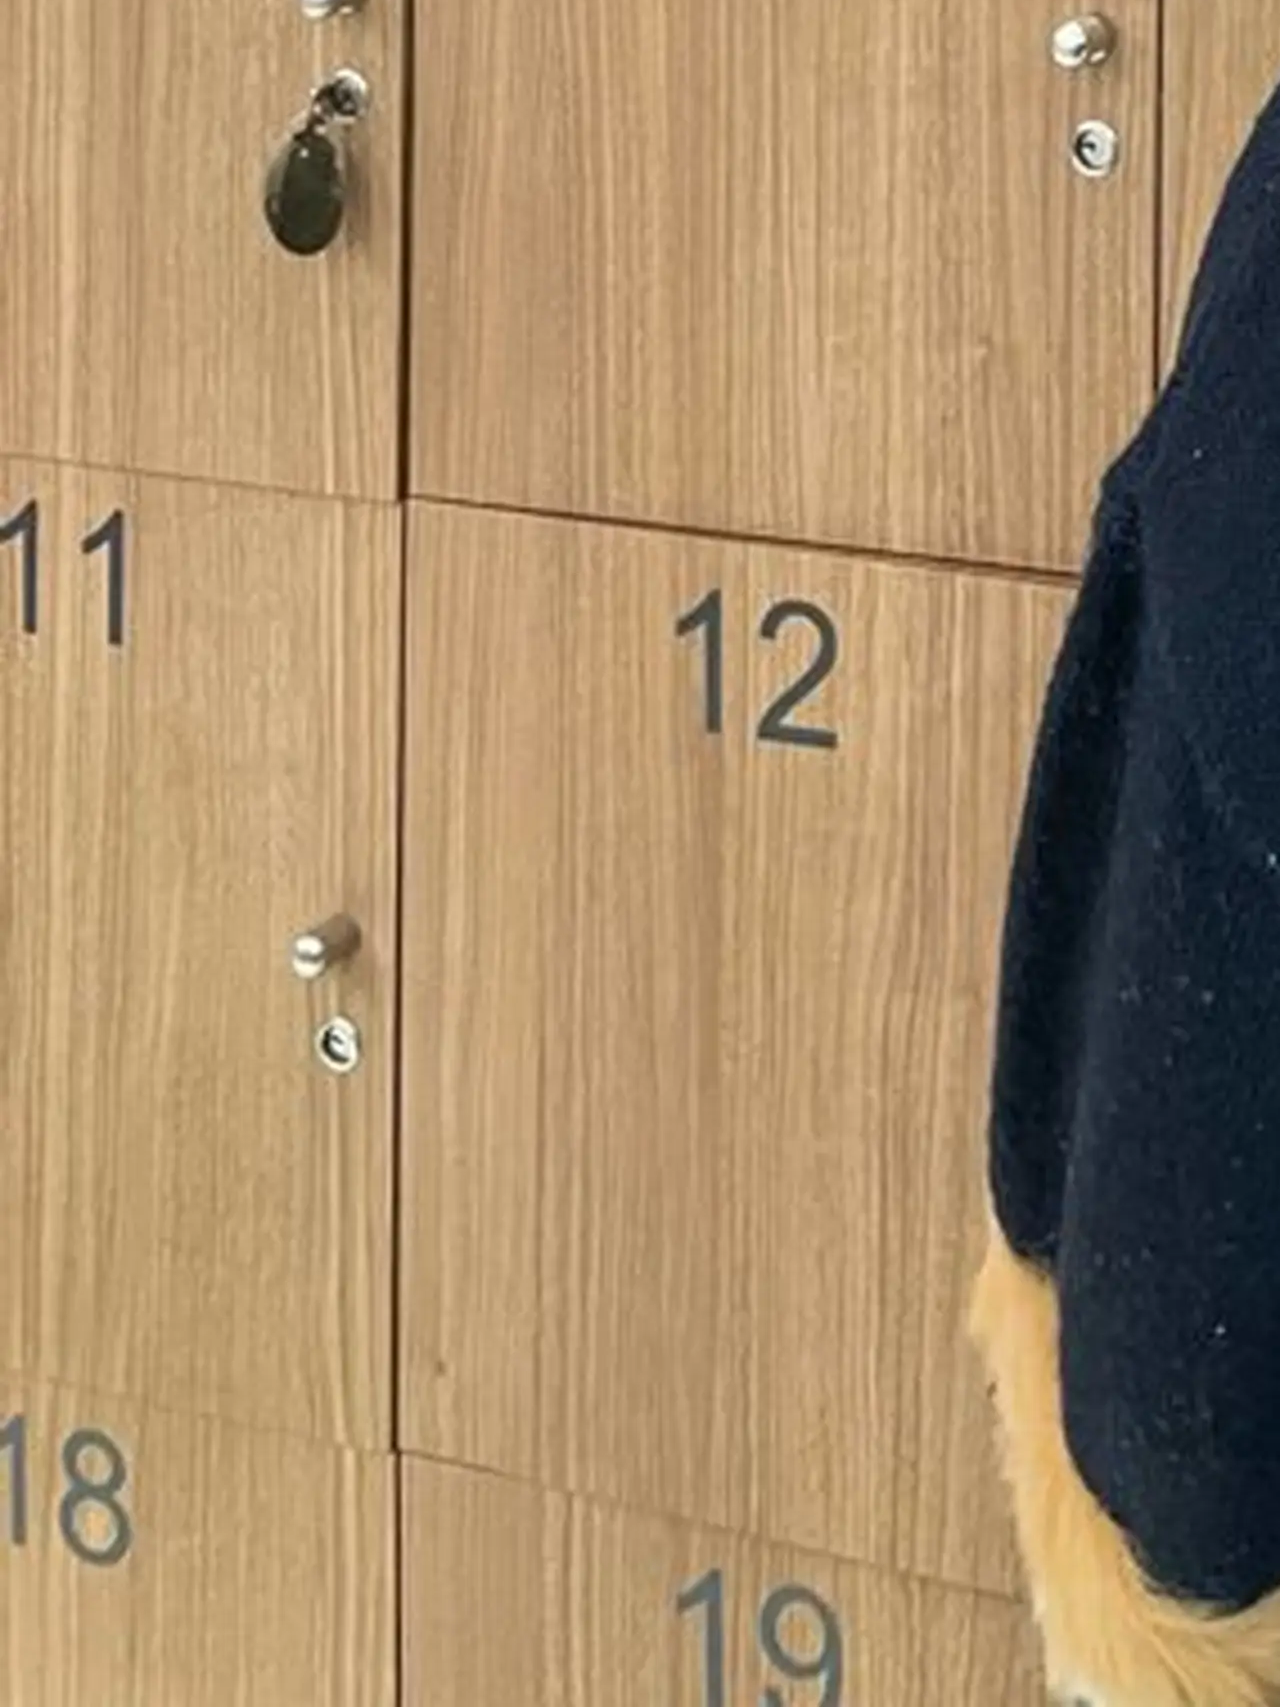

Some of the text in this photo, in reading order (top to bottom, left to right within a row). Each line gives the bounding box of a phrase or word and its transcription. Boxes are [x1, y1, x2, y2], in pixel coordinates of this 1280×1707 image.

[0, 499, 123, 645] 11
[676, 588, 838, 748] 12
[0, 1415, 133, 1567] 18
[676, 1568, 843, 1707] 19
